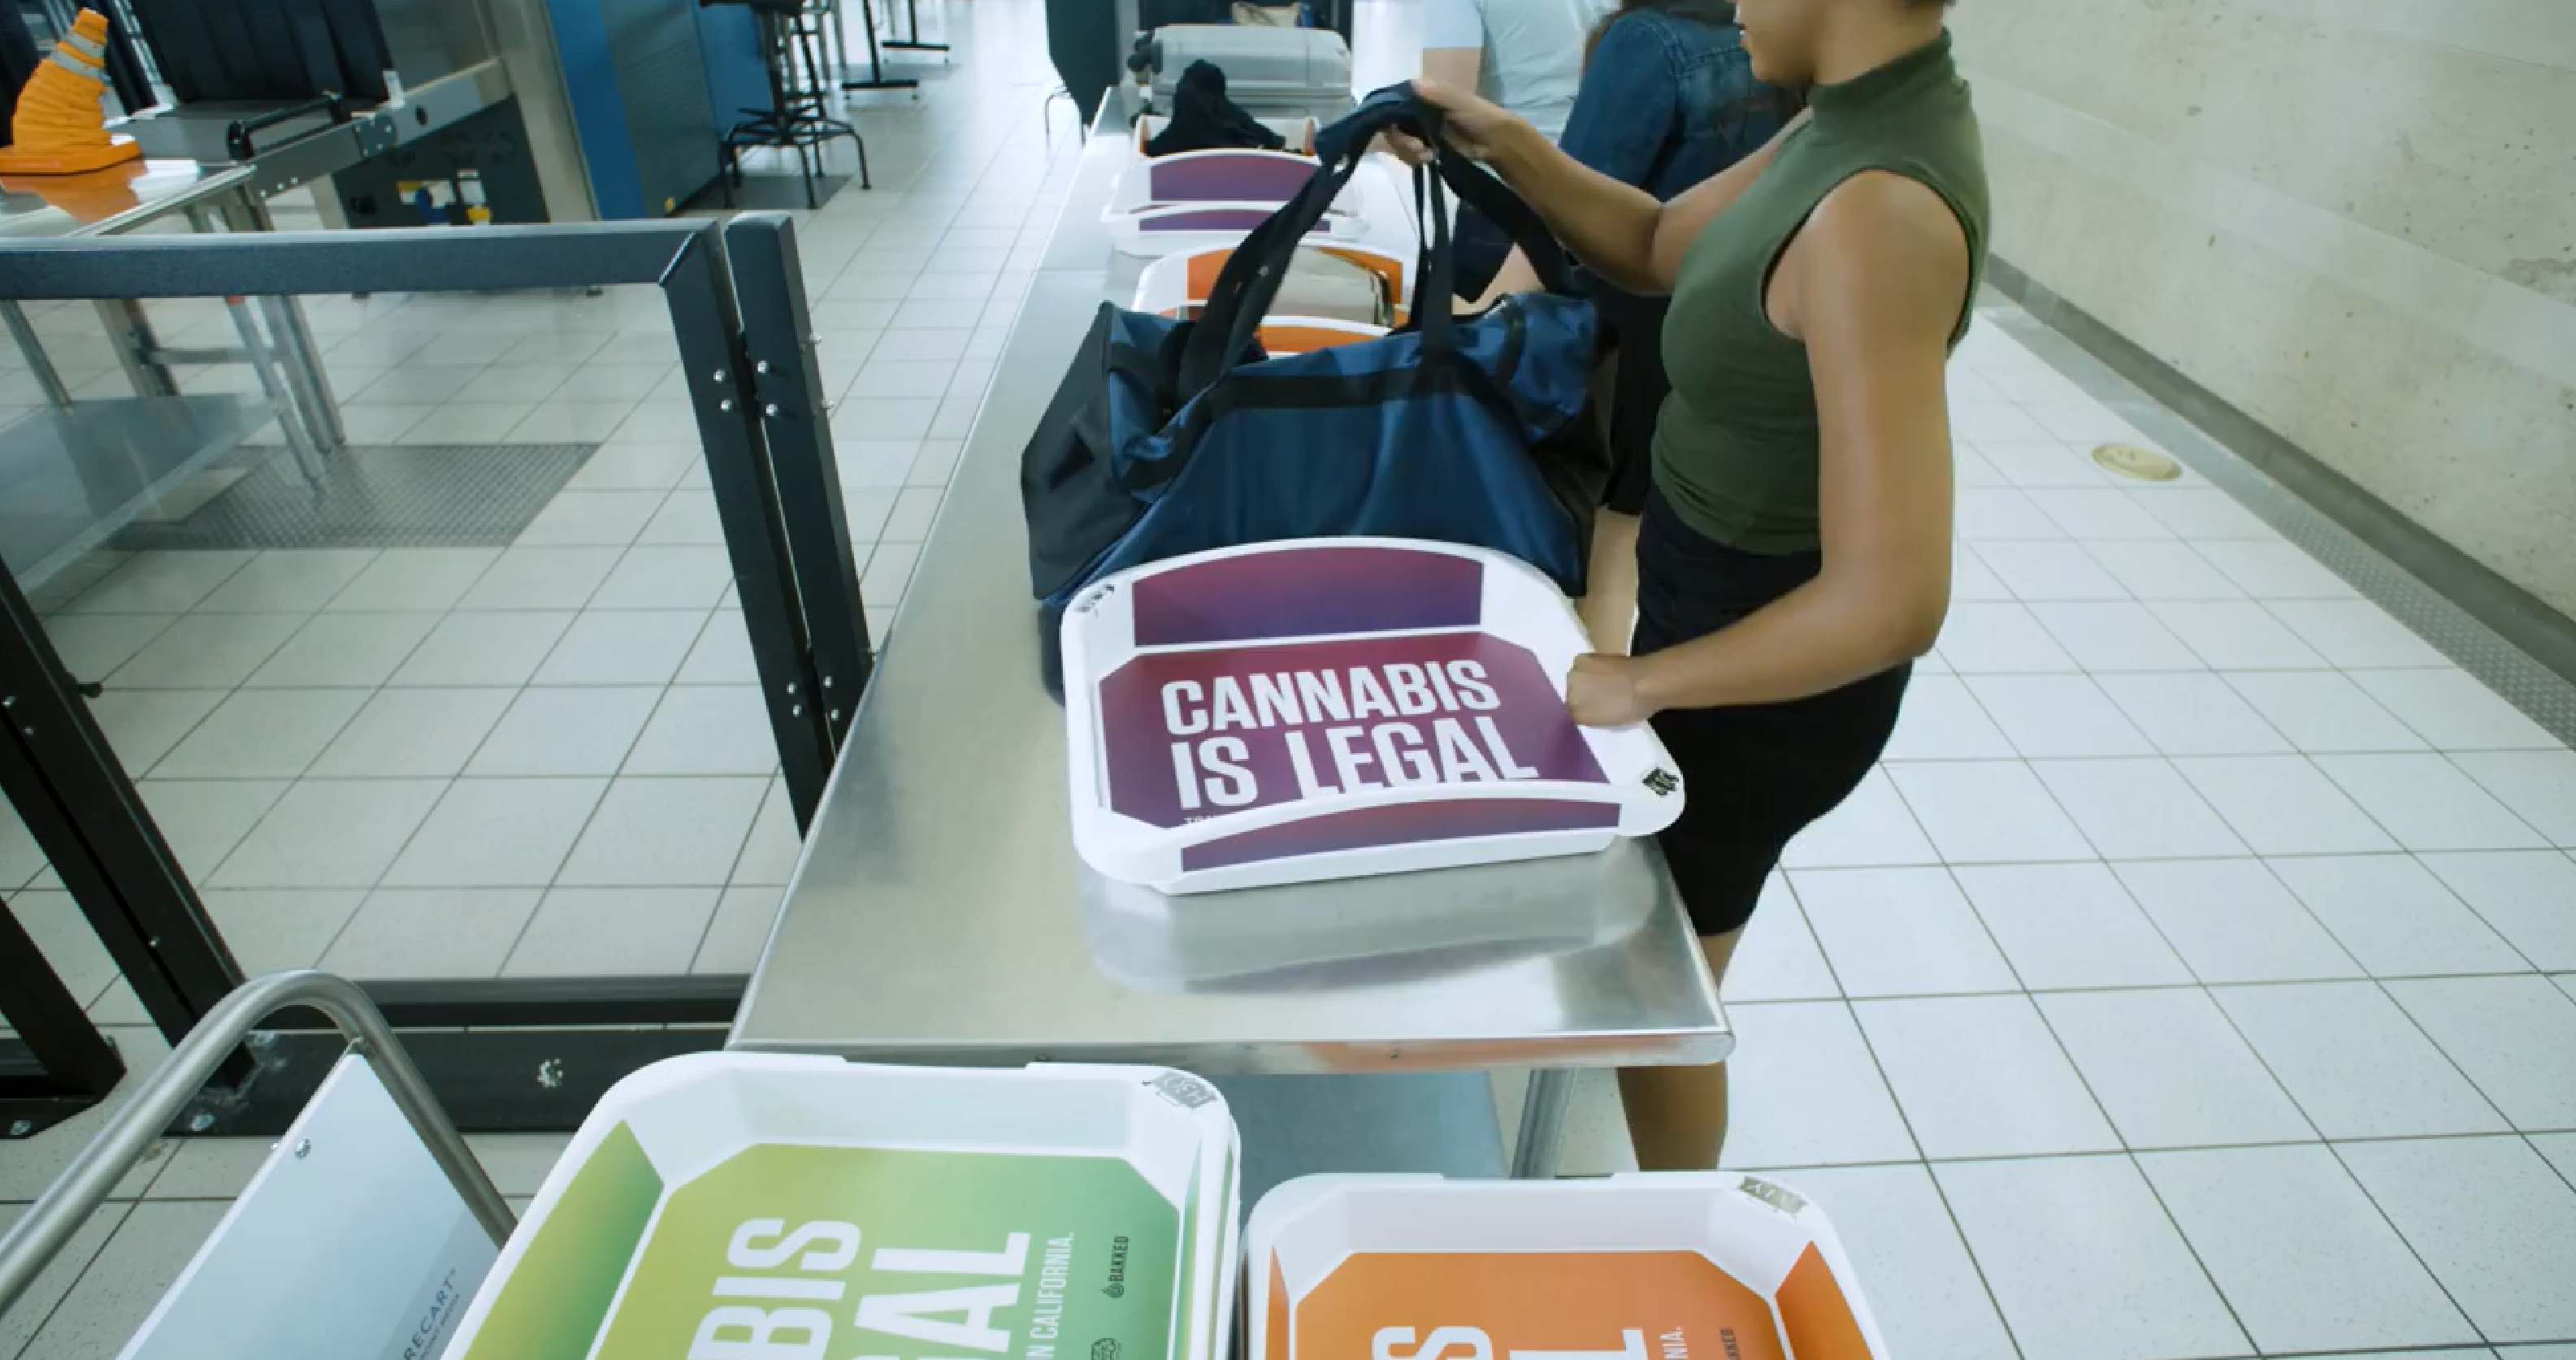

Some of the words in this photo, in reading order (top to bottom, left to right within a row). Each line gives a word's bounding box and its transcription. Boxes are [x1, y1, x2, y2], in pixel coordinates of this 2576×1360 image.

[1161, 659, 1501, 736] CANNABIS
[1170, 737, 1258, 810] IS
[1284, 715, 1538, 799] LEGAL
[848, 1232, 1030, 1360] AL
[1030, 1231, 1074, 1338] CALIFORNIA.
